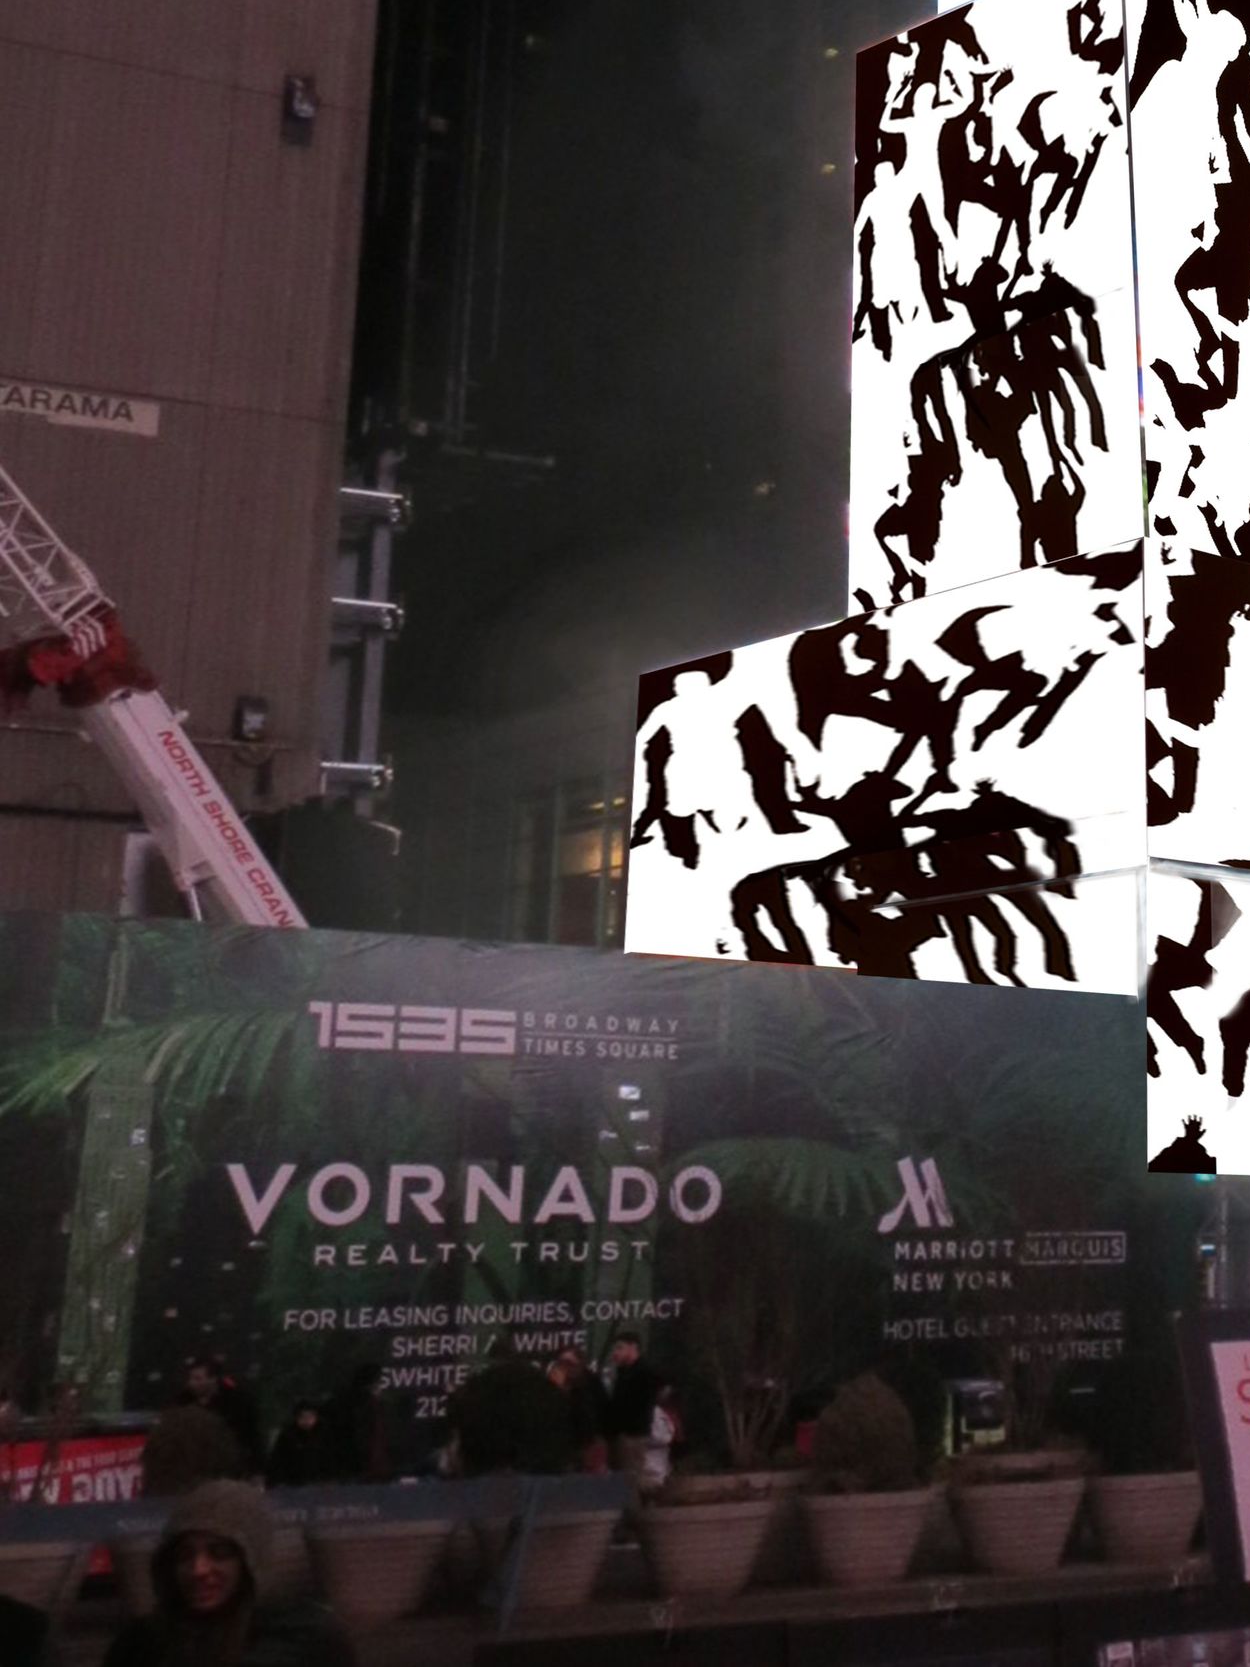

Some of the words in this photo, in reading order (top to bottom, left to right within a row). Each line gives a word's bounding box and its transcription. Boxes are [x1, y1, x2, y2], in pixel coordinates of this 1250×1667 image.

[158, 730, 211, 798] NORTH
[203, 800, 255, 866] SHORE
[307, 1000, 517, 1055] 1535
[522, 1011, 680, 1034] BROADWAY
[522, 1037, 587, 1057] TIMES
[596, 1039, 680, 1061] SQUARE
[226, 1162, 723, 1235] VORNADO
[313, 1241, 486, 1267] REALTY
[510, 1239, 651, 1263] TRUST
[894, 1238, 1015, 1261] MARRIOTT
[892, 1271, 945, 1292] NEW
[953, 1269, 1014, 1290] YORK
[283, 1308, 335, 1332] FOR
[343, 1304, 449, 1330] LEASING
[455, 1301, 575, 1328] INQUIRIES,
[580, 1297, 684, 1322] CONTACT
[882, 1317, 949, 1341] HOTEL
[391, 1334, 476, 1359] SHERRI
[514, 1330, 587, 1354] WHITE
